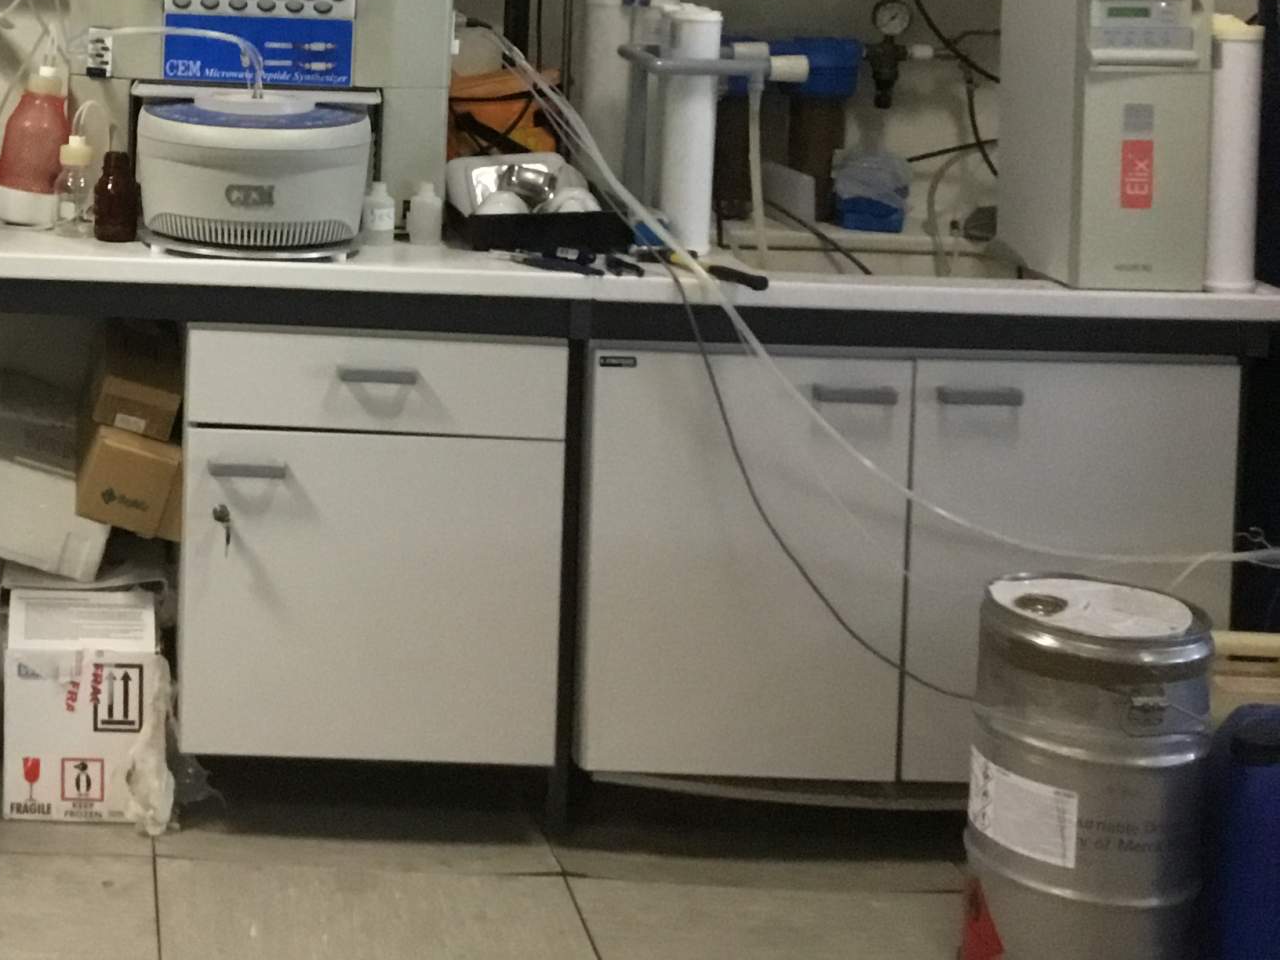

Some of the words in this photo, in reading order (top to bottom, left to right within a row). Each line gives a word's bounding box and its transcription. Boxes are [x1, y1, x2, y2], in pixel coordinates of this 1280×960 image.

[165, 59, 202, 77] CEM
[260, 70, 291, 83] eptide
[1125, 158, 1149, 195] Elix
[10, 802, 52, 815] FRAGILE
